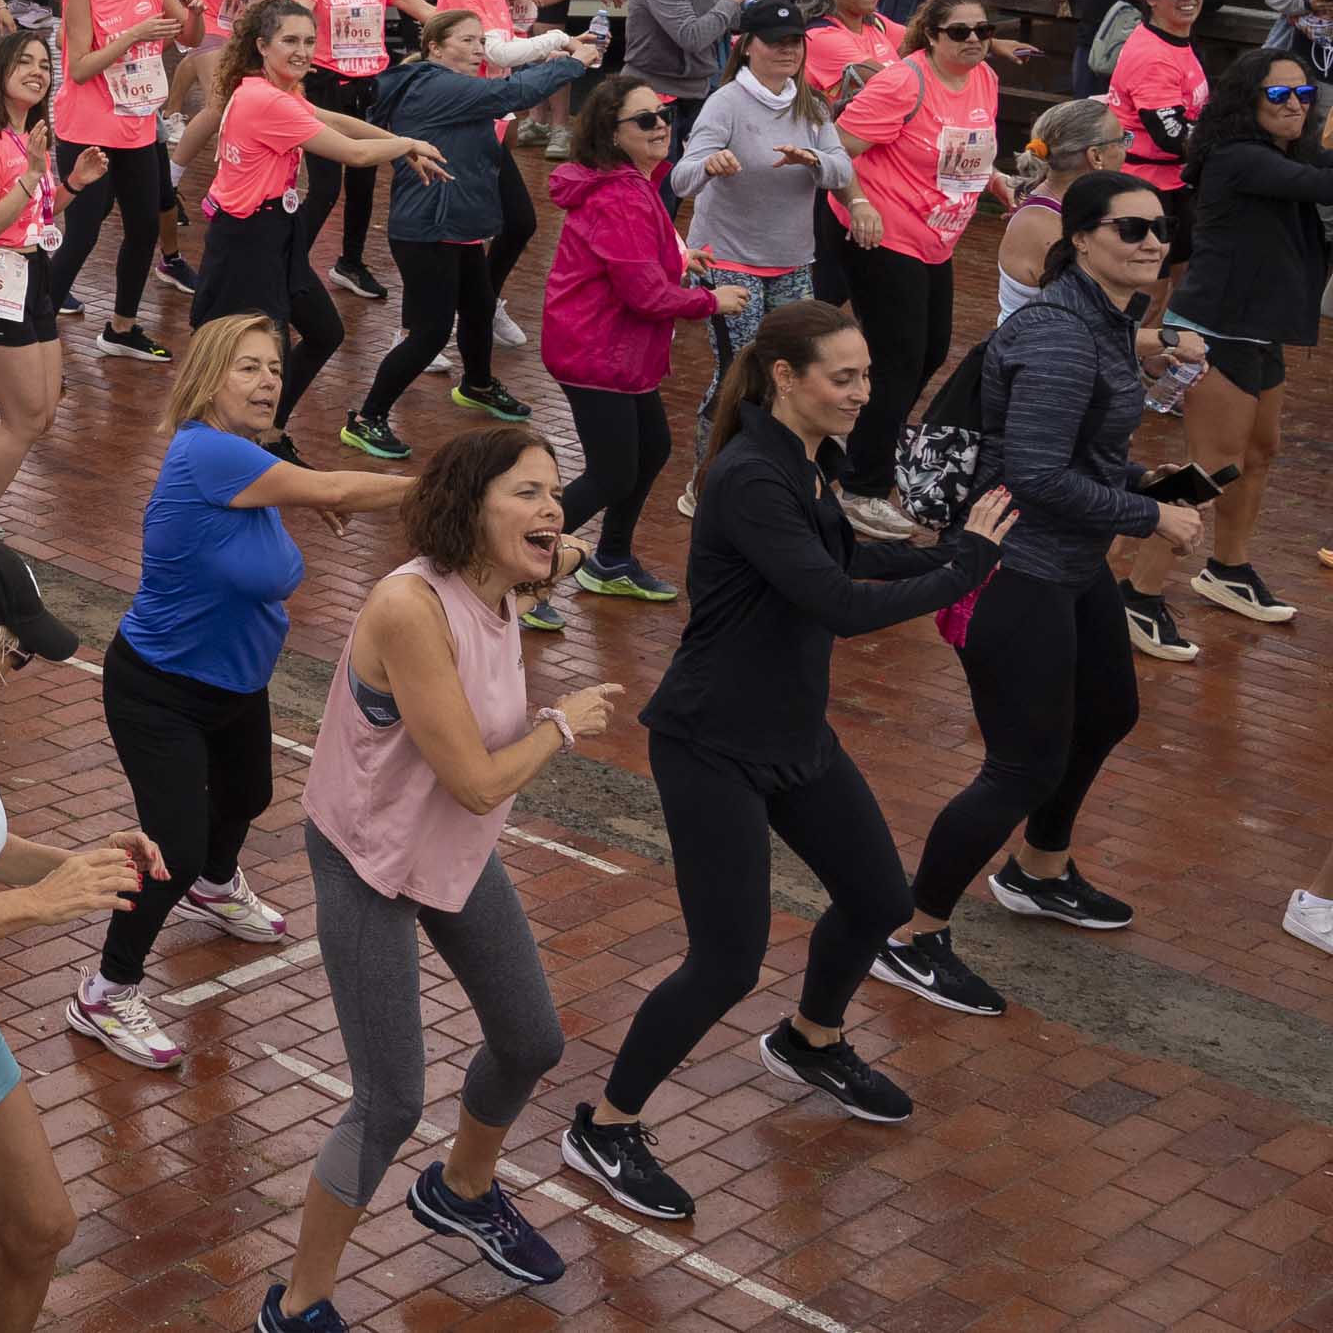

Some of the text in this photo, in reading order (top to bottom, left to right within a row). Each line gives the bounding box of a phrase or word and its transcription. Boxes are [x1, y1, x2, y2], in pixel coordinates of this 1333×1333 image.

[351, 29, 371, 38] 016
[130, 84, 153, 96] 016
[961, 158, 980, 169] 016
